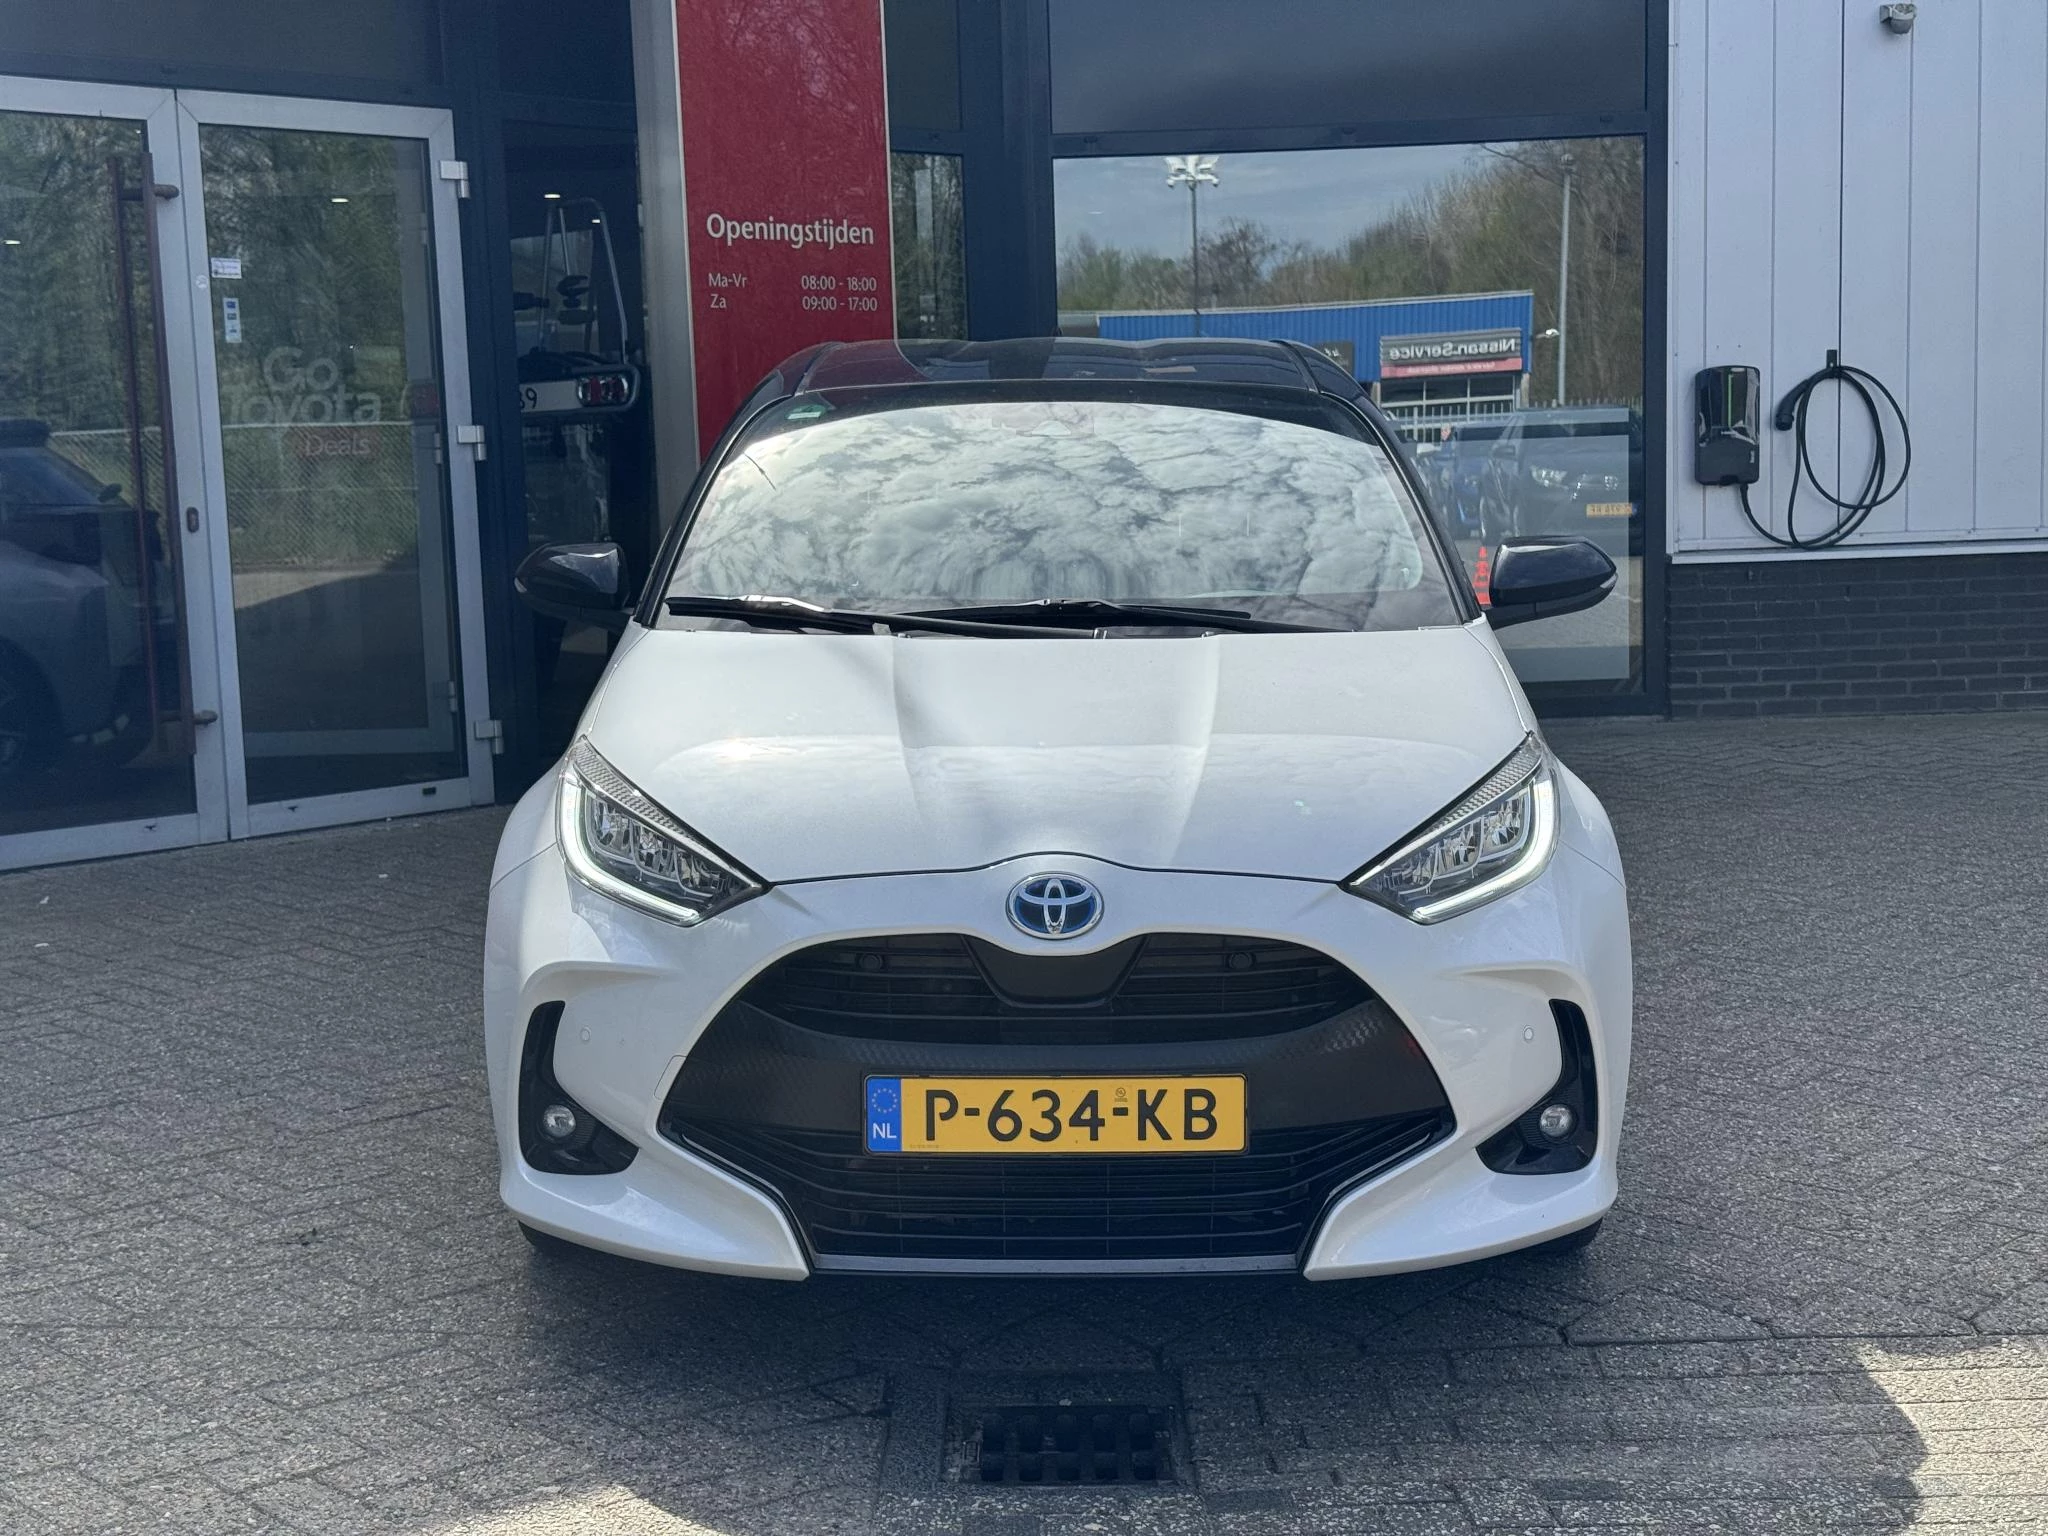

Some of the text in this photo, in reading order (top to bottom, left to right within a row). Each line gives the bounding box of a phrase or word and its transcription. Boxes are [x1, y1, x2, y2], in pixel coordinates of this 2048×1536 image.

[706, 213, 874, 250] Openingstijden
[708, 272, 747, 288] Ma-Vr
[801, 275, 836, 290] 08:00
[847, 276, 877, 291] 18:00
[710, 293, 727, 309] Za
[802, 296, 837, 310] 09:00
[849, 297, 877, 312] 17:00
[263, 347, 338, 392] Go
[302, 431, 370, 457] Deals
[872, 1122, 897, 1139] NL
[925, 1088, 1218, 1141] P-634-KB
